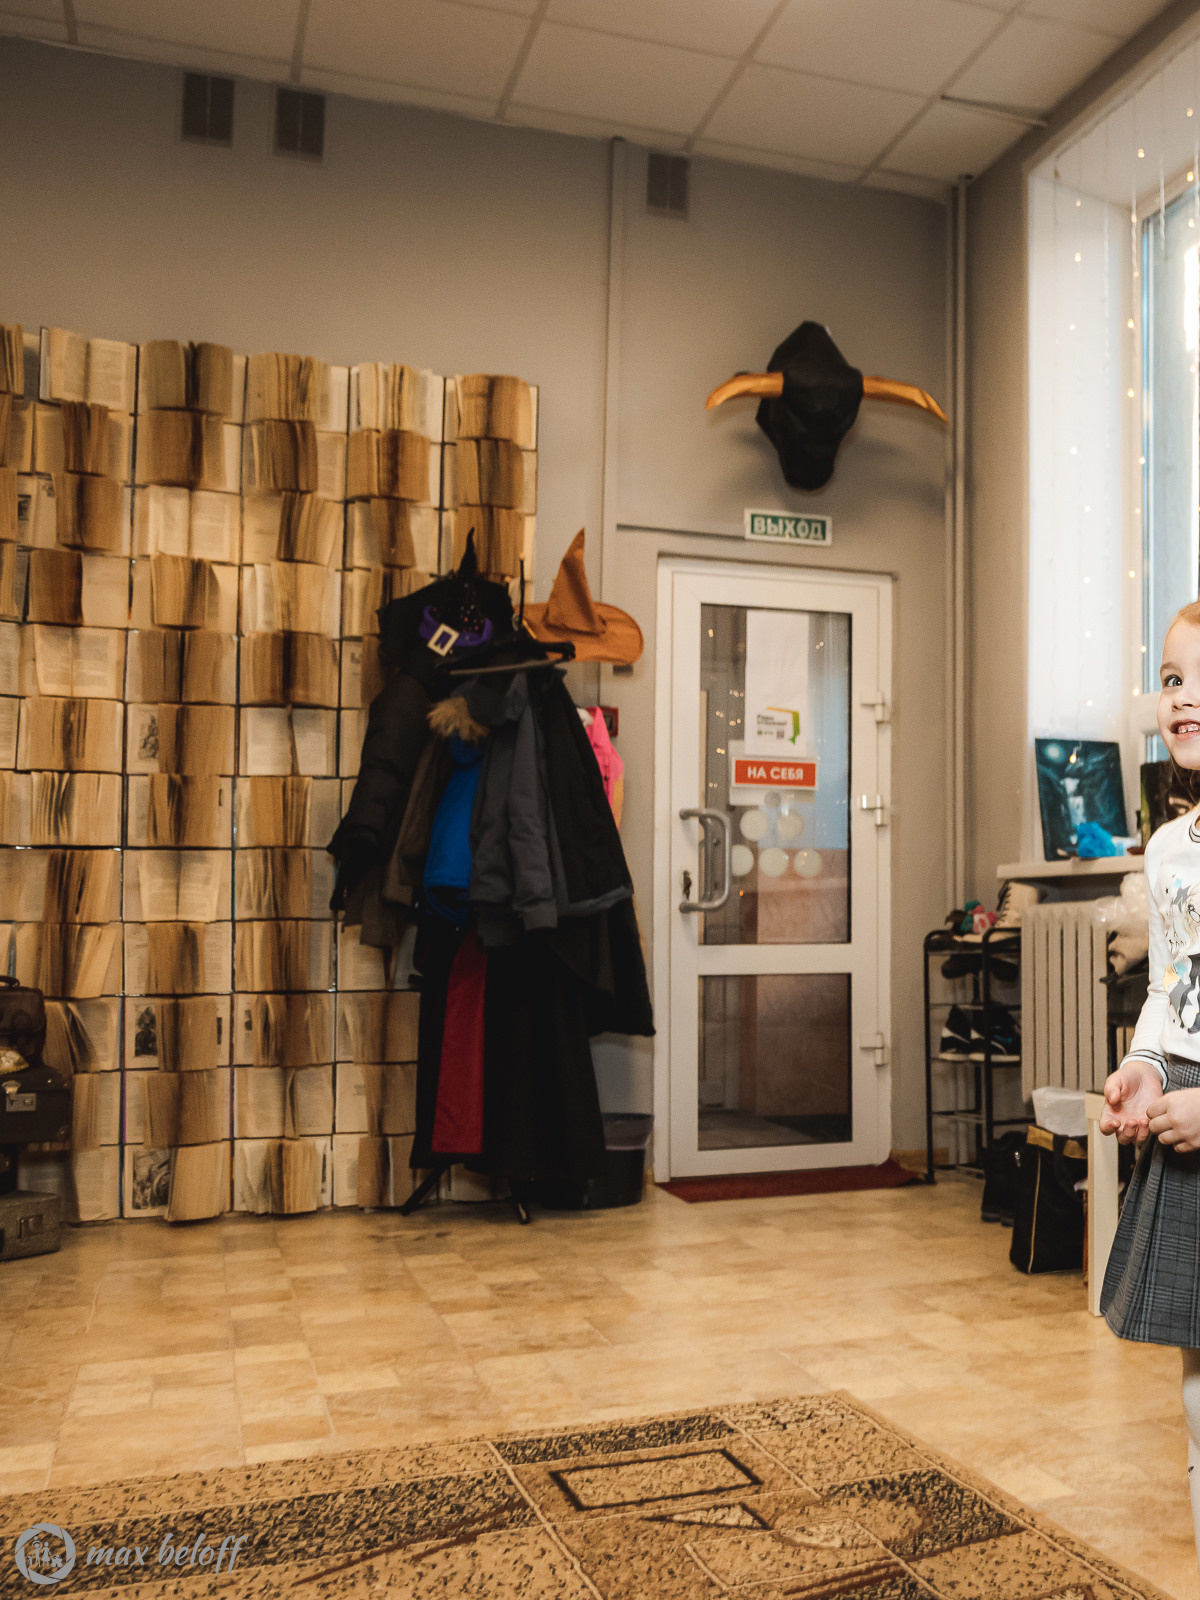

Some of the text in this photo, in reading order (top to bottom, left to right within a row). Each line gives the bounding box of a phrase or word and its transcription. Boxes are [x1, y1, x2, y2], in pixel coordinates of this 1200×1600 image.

[753, 516, 824, 541] ВЫХОД
[747, 765, 804, 781] НА СЕБЯ
